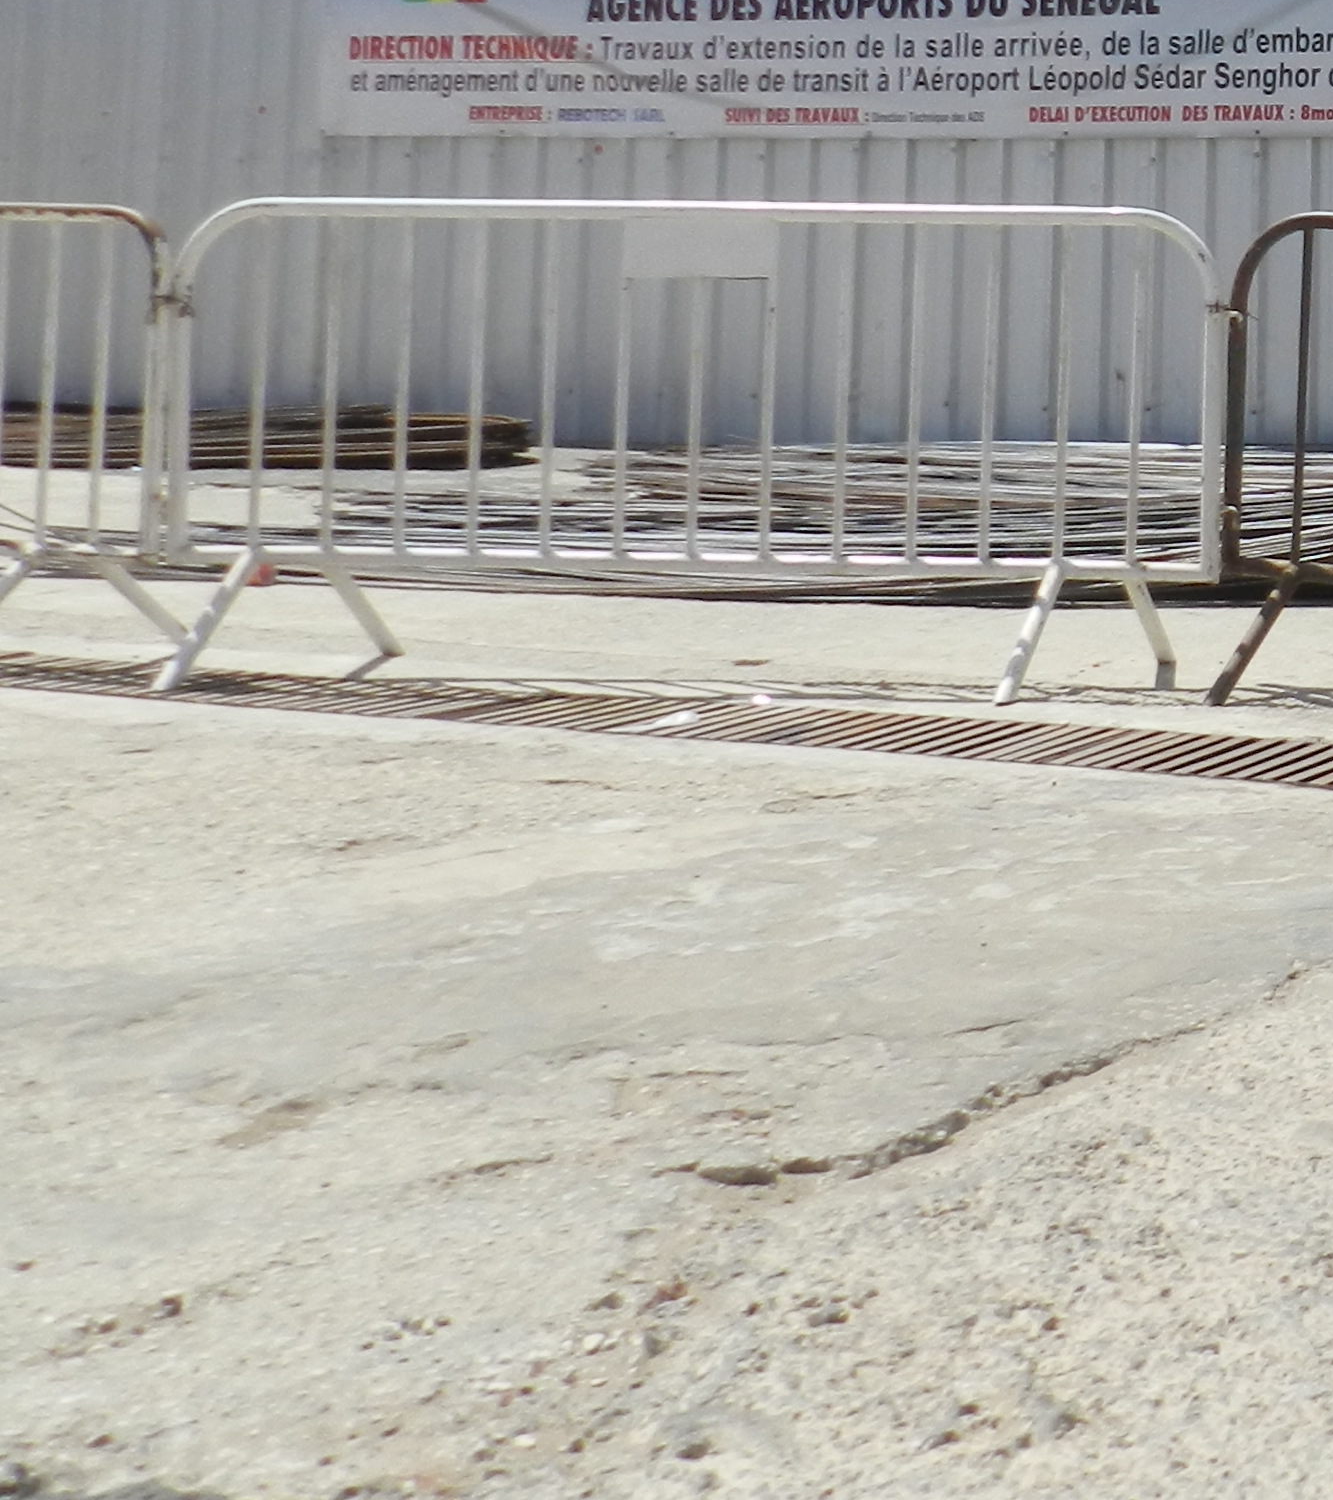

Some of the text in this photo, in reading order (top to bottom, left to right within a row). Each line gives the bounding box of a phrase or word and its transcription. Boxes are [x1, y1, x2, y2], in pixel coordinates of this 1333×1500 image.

[349, 35, 454, 60] DIRECTION
[461, 35, 578, 61] TECHNIQUE
[601, 36, 694, 60] Travaux
[856, 33, 885, 59] de
[895, 33, 915, 58] la
[925, 32, 985, 58] salle
[994, 31, 1091, 61] arrivée,
[1102, 30, 1131, 56] de
[1141, 30, 1160, 55] la
[1169, 28, 1225, 55] salle
[351, 73, 368, 92] et
[375, 69, 519, 98] aménagement
[593, 68, 688, 92] nouvelle
[696, 68, 749, 92] salle
[757, 68, 786, 92] de
[793, 68, 869, 92] transit
[877, 67, 890, 92] à
[1029, 64, 1127, 96] Léopold
[1134, 63, 1207, 89] Sédar
[1214, 62, 1321, 95] Senghor
[469, 106, 543, 120] ENTREPRISE
[725, 107, 761, 122] SUIVI
[766, 107, 790, 122] DES
[795, 106, 860, 122] TRAVAUX
[1028, 106, 1069, 122] DELAI
[1181, 105, 1208, 121] DES
[1214, 104, 1284, 121] TRAVAUX
